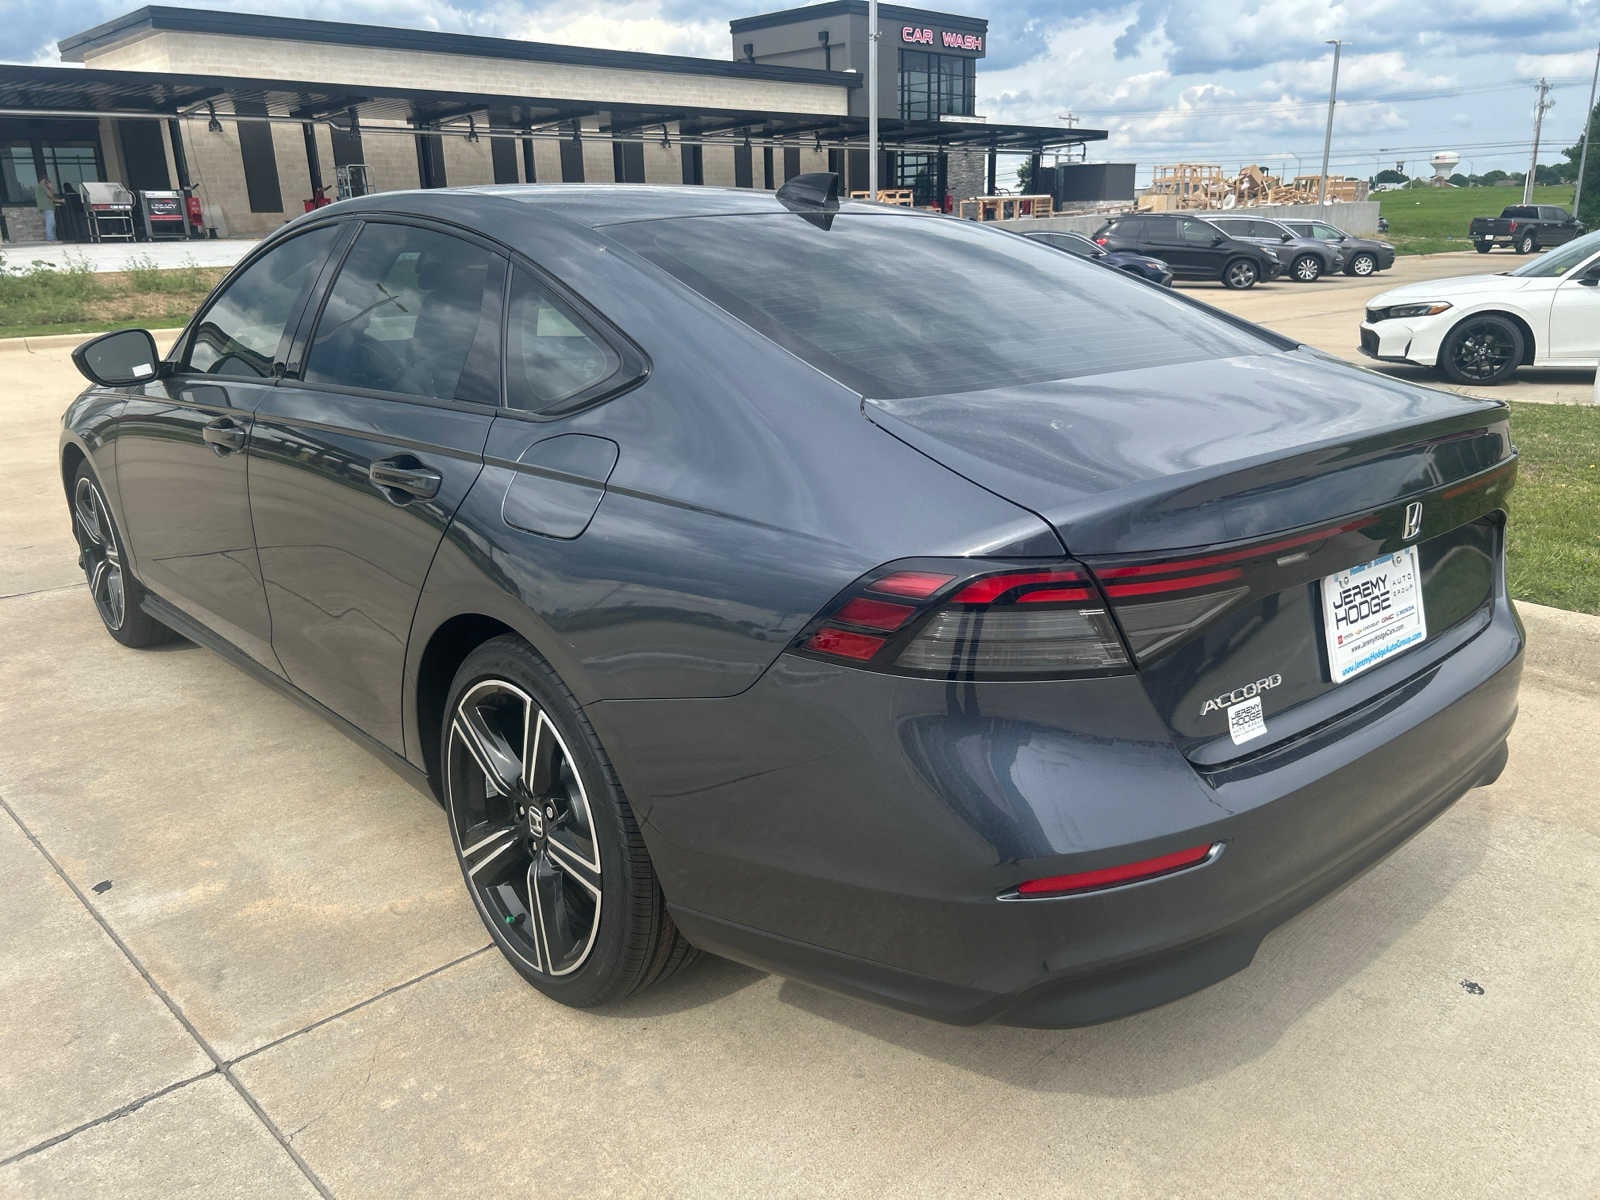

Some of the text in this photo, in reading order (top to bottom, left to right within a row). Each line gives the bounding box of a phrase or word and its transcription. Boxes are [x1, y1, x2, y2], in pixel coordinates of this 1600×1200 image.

[902, 27, 982, 50] CAR WASH
[1333, 574, 1387, 609] JEREMY
[1393, 573, 1412, 587] AUTO
[1335, 590, 1391, 630] HODGE
[1200, 673, 1282, 716] ACCORD
[1232, 703, 1260, 719] JEREMY
[1232, 710, 1262, 728] HODGE
